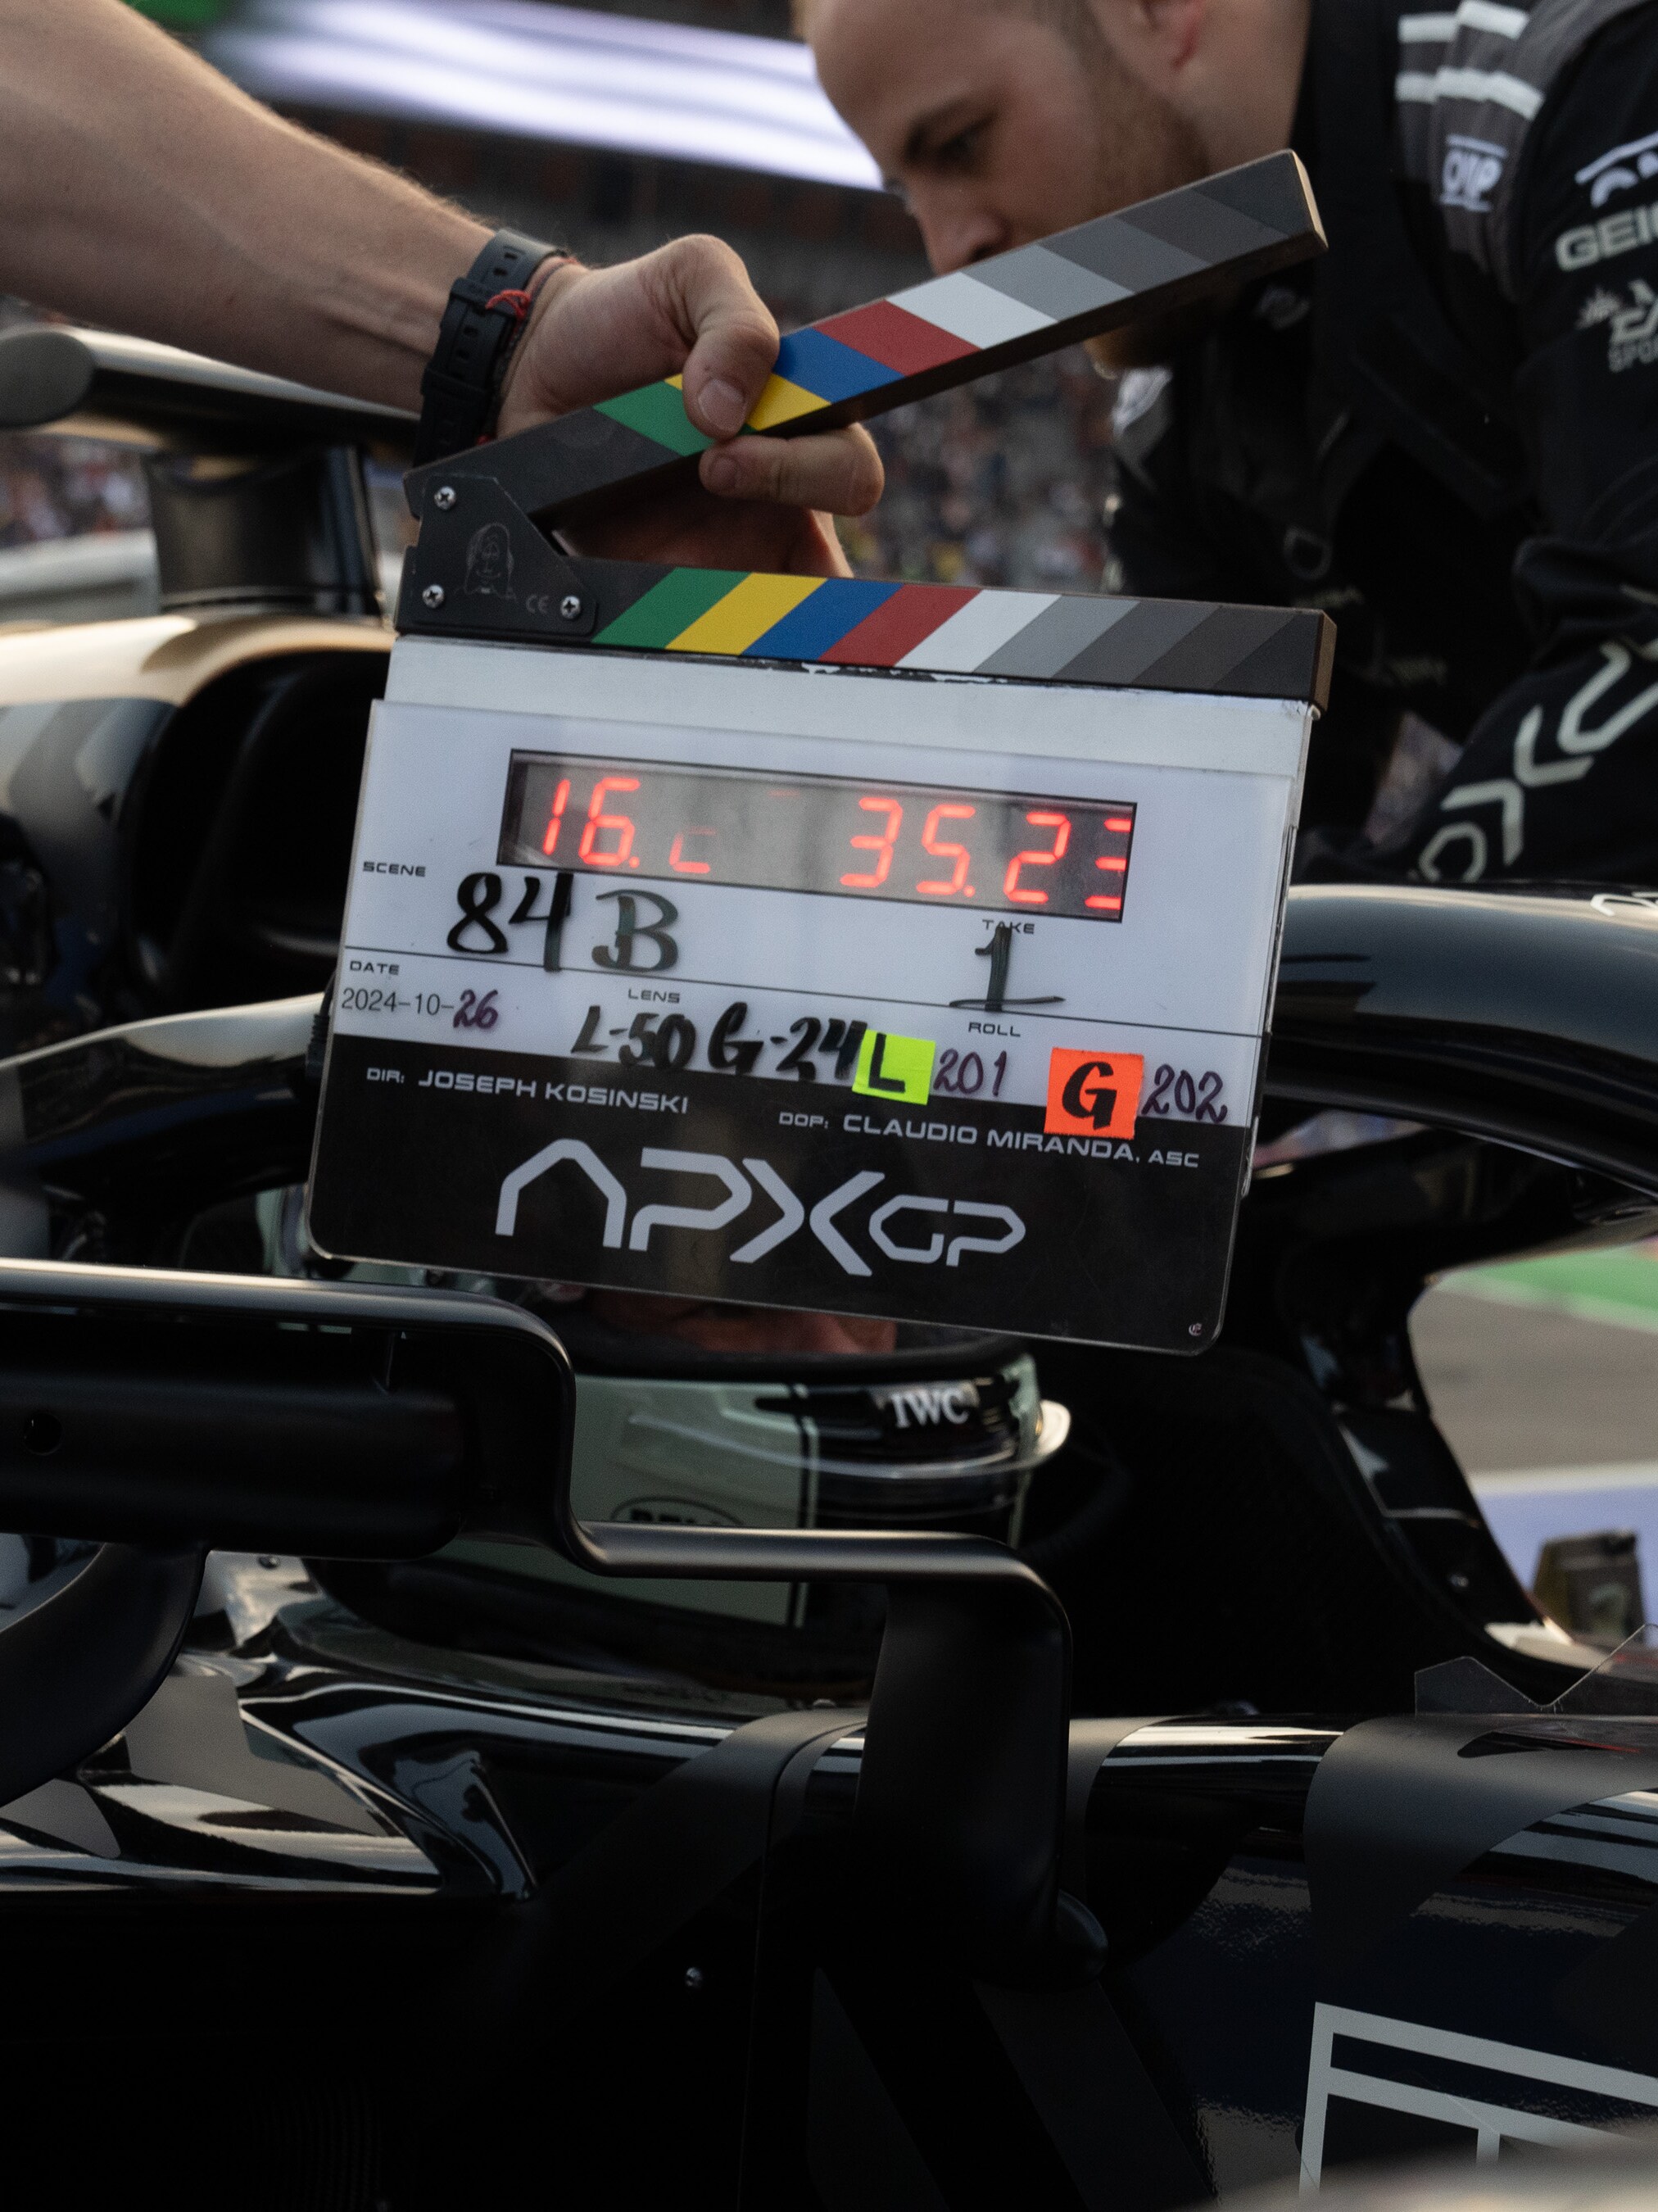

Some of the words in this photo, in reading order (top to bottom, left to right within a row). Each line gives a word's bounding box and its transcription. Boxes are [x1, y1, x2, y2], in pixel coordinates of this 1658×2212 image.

[1556, 202, 1658, 271] GEI
[363, 861, 426, 877] SCENE
[350, 960, 400, 976] DATE
[949, 922, 1066, 1013] 1
[628, 988, 681, 1004] LENS
[968, 1022, 1021, 1037] ROLL
[366, 1067, 405, 1084] DIR:
[418, 1069, 537, 1098] JOSEPH
[545, 1082, 689, 1114] KOSINSKI
[868, 1032, 906, 1094] L
[932, 1048, 1008, 1098] 201
[1062, 1060, 1117, 1131] G
[1141, 1063, 1228, 1125] 202
[778, 1111, 830, 1129] DOP:
[843, 1114, 978, 1145] CLAUDIO
[1148, 1149, 1199, 1168] ASC
[890, 1388, 970, 1429] IWC
